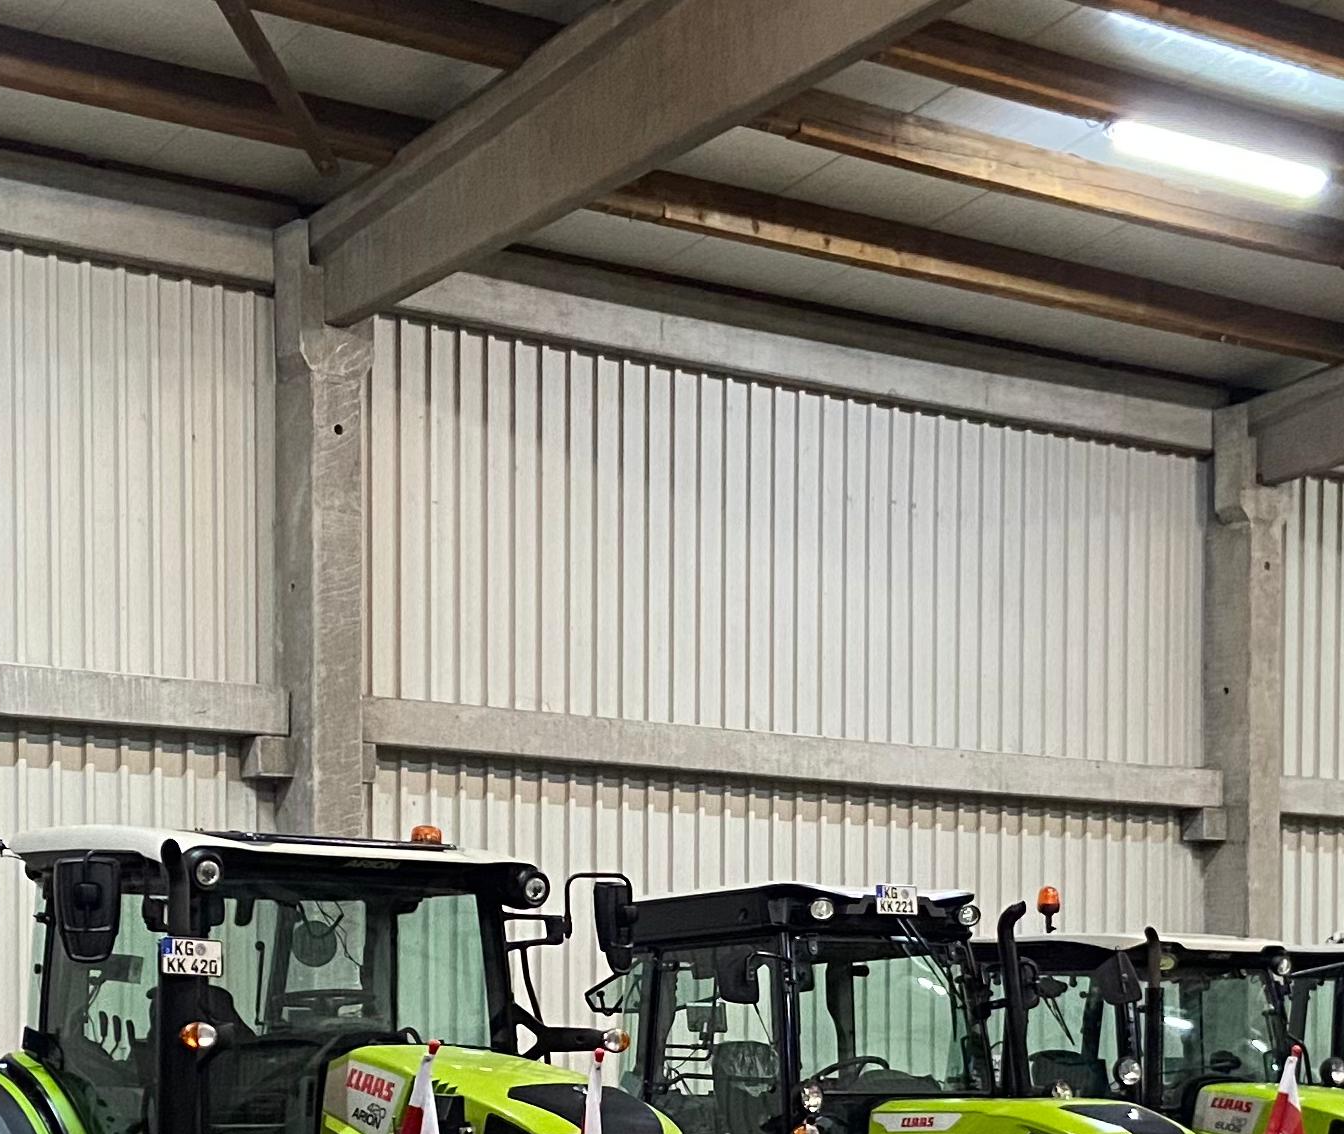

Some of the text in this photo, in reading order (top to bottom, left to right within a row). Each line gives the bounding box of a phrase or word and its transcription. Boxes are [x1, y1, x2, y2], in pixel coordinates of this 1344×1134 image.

[884, 886, 898, 899] KG
[880, 900, 914, 913] KK 221
[175, 940, 194, 957] KG
[166, 957, 218, 975] KK 420
[346, 1067, 396, 1103] CLAAS
[1210, 1097, 1254, 1114] CLAAS
[901, 1116, 935, 1128] CLAAS
